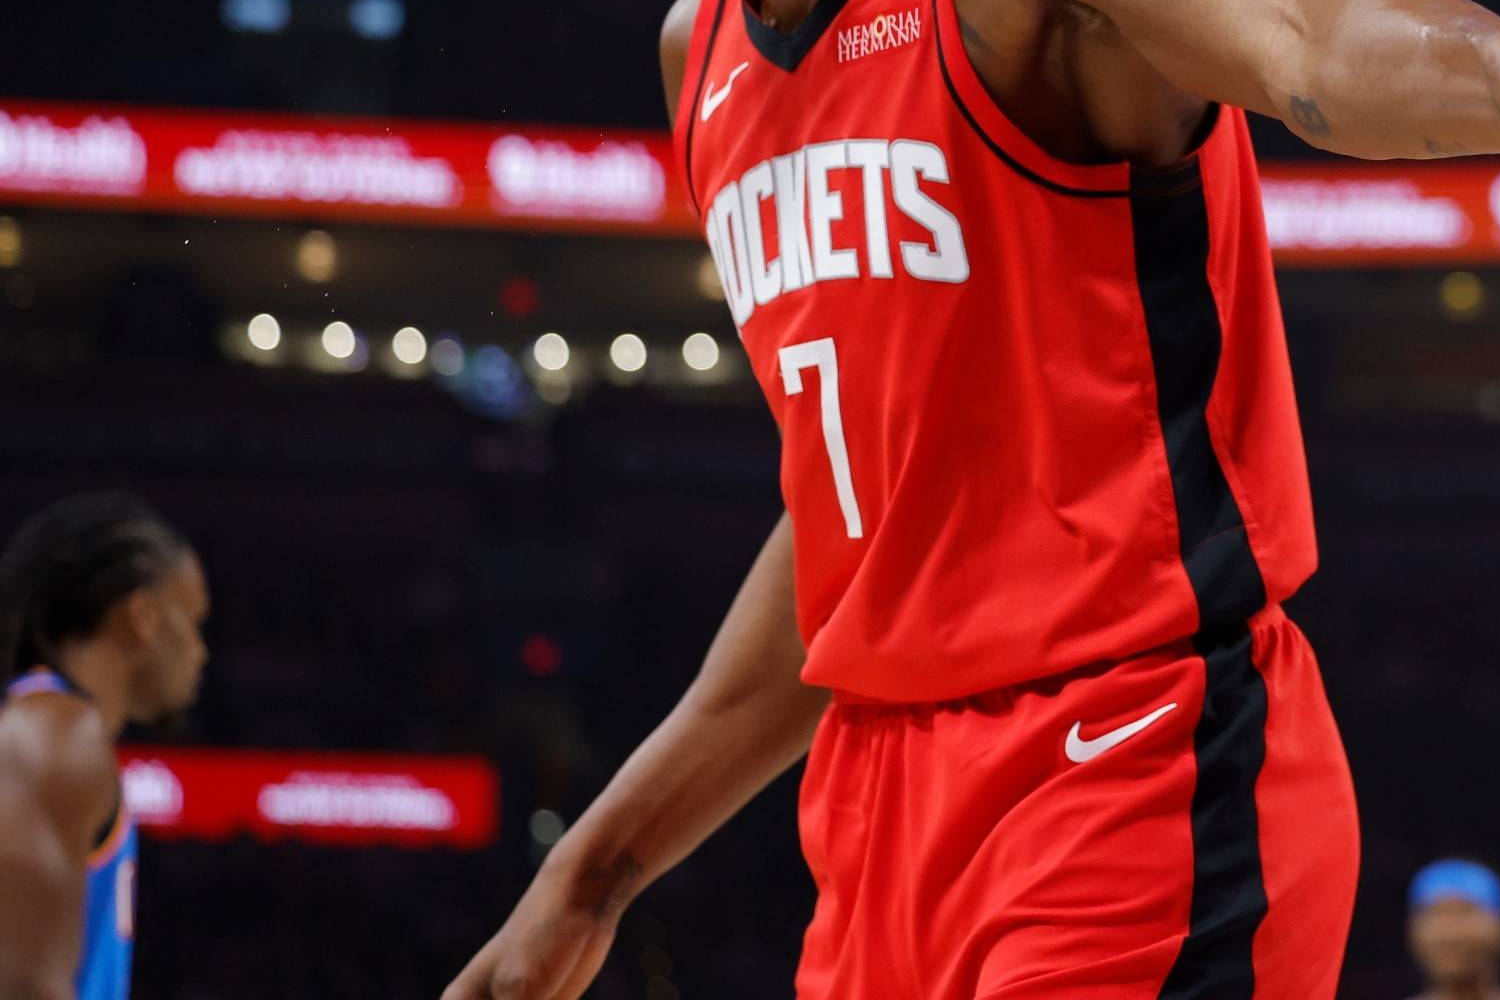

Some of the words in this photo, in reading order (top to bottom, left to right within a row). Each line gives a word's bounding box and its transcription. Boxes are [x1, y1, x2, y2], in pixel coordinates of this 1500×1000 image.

[838, 8, 921, 48] MEMORIAL
[838, 22, 921, 63] HERMANN
[778, 337, 863, 539] 7
